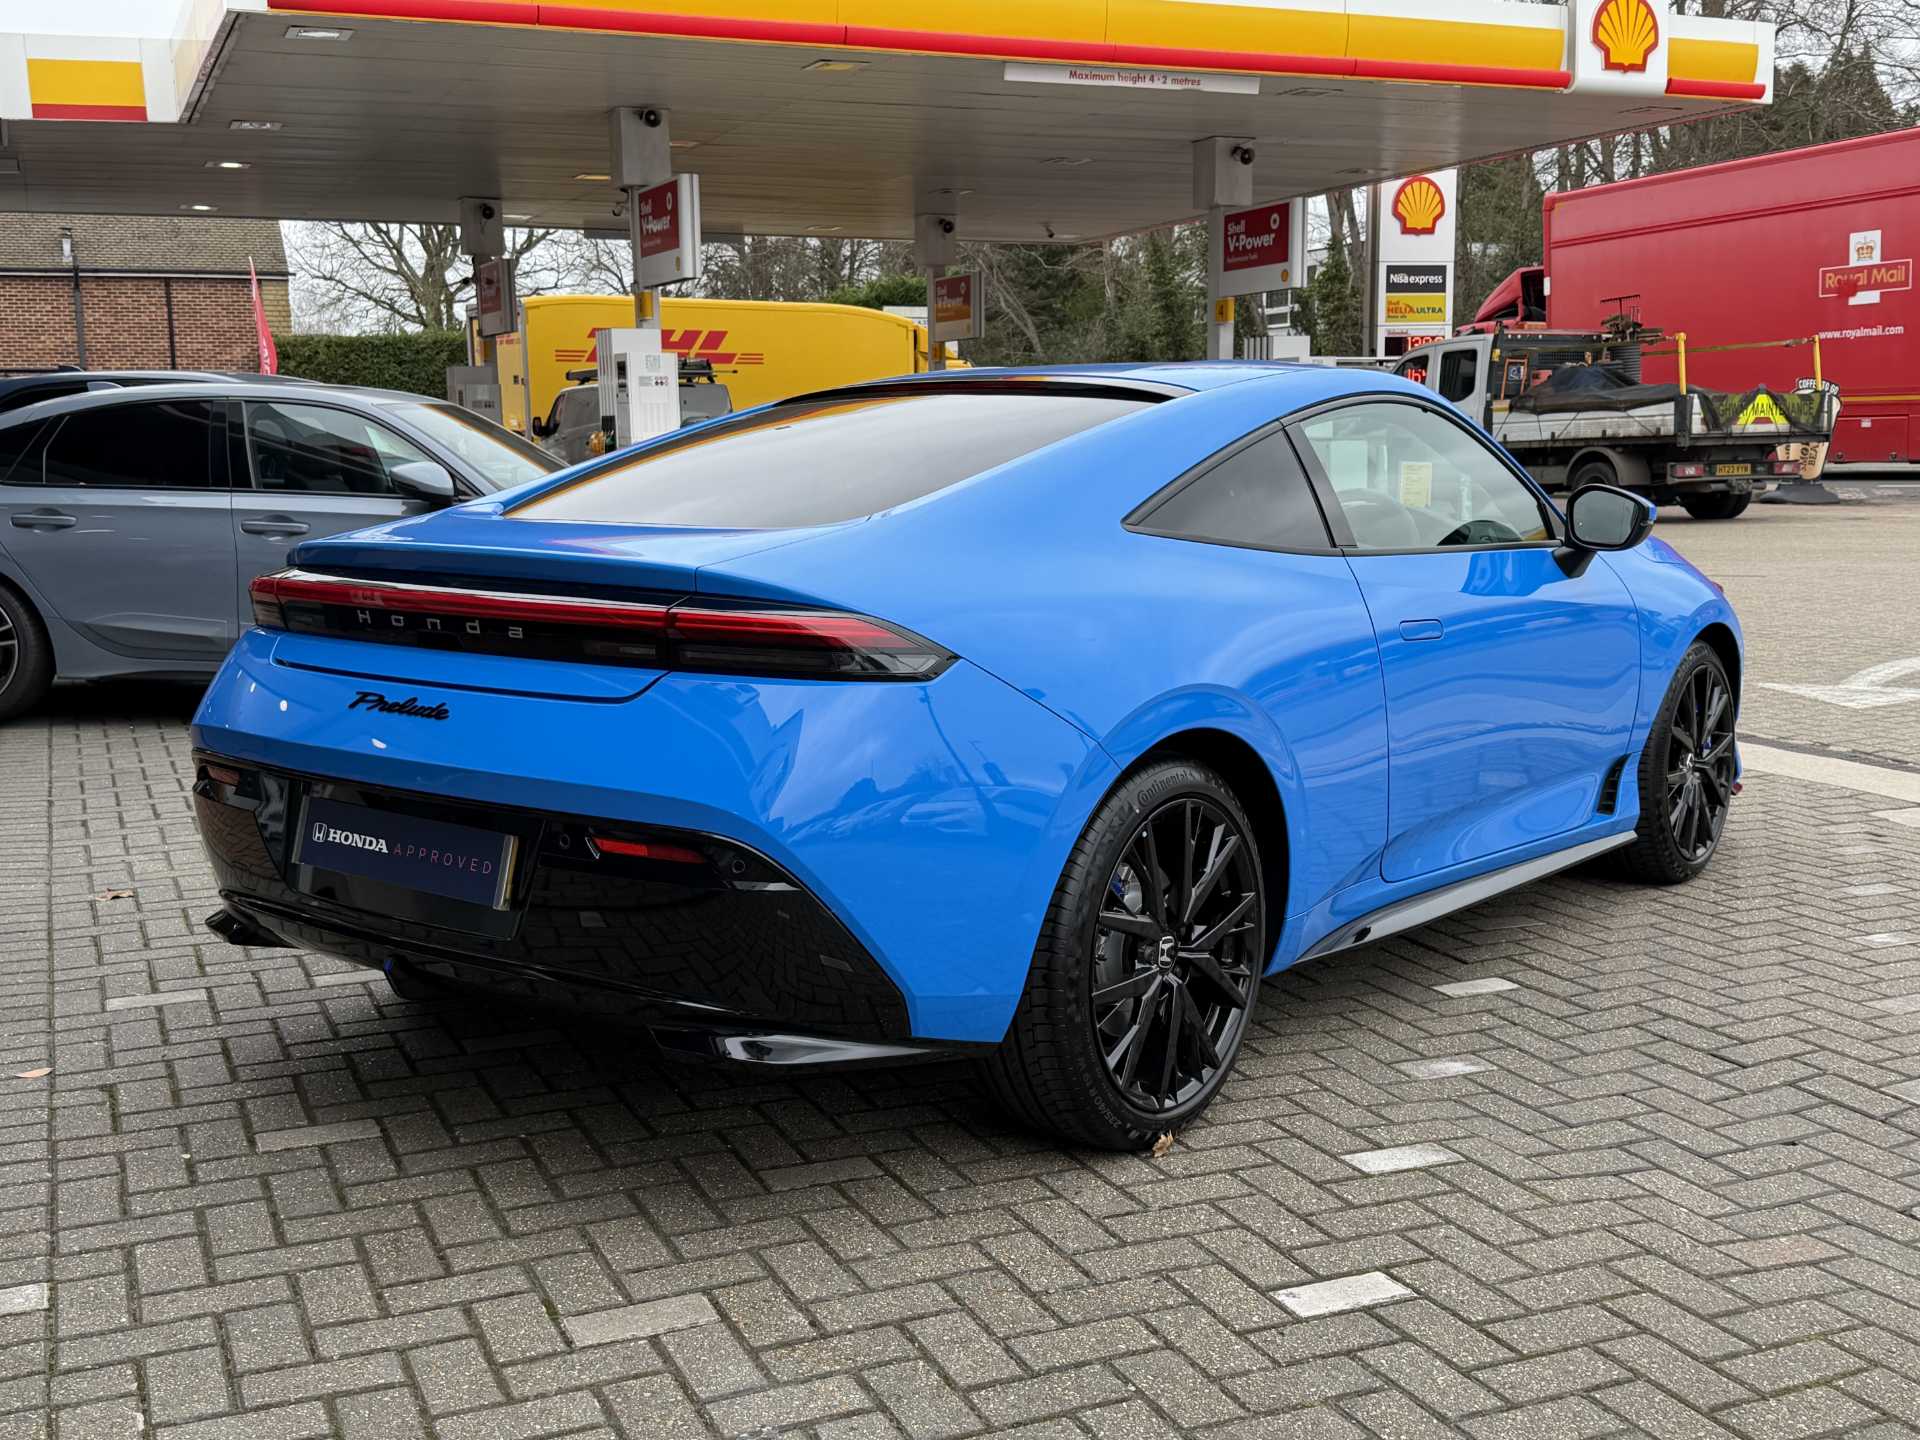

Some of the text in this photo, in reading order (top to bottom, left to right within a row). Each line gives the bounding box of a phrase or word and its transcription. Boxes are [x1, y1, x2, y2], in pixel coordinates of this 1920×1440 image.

[1068, 69, 1116, 81] Maximum
[1117, 72, 1147, 84] height
[1171, 77, 1201, 86] metres
[1227, 219, 1246, 235] Shell
[1409, 274, 1443, 285] express
[1871, 265, 1906, 285] Mail
[1819, 324, 1904, 339] www.royalmail.com
[356, 609, 523, 640] Honda
[347, 691, 450, 720] Prelude
[327, 828, 493, 875] HONDA APPROVED
